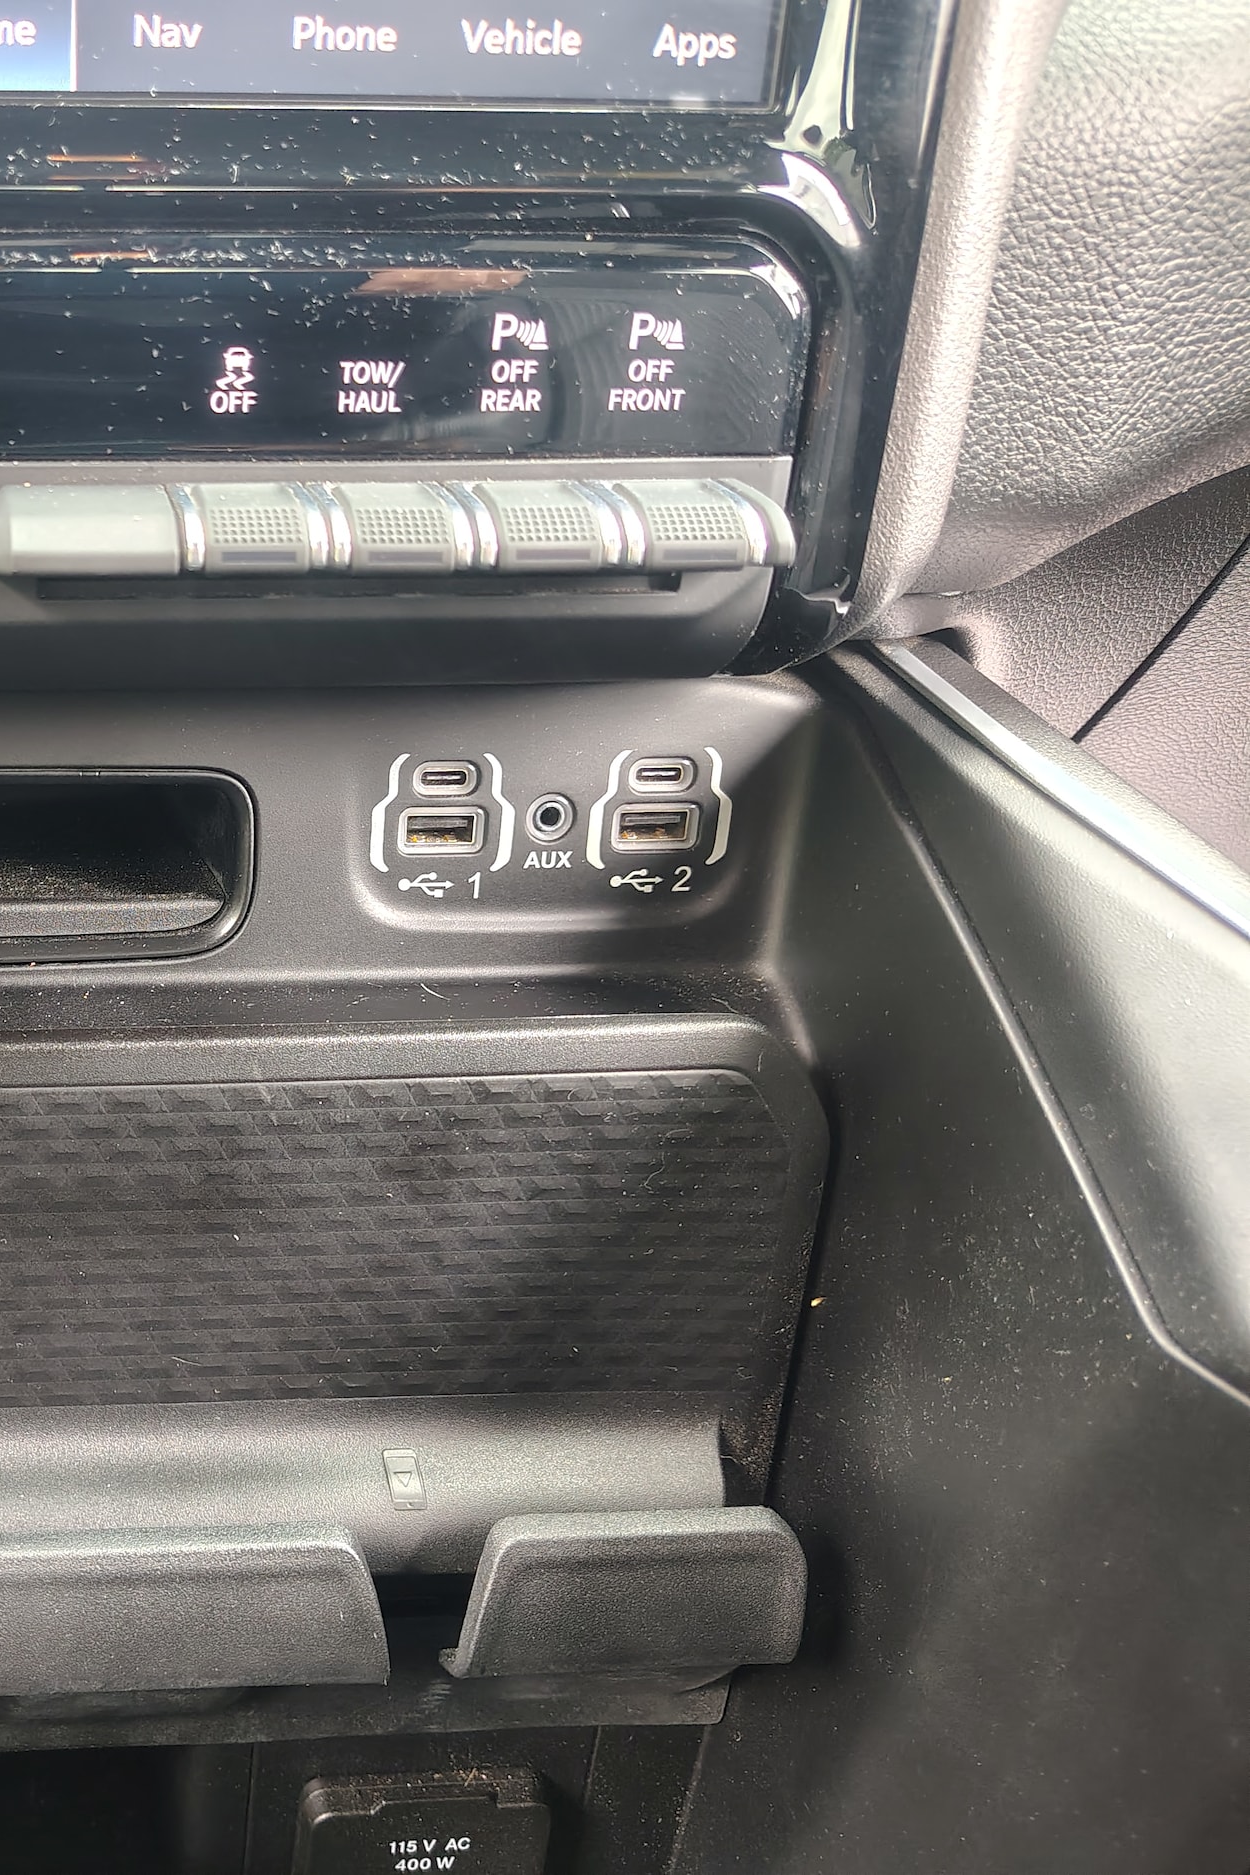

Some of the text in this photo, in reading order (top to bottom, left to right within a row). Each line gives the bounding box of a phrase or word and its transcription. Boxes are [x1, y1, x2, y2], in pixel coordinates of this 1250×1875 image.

[133, 14, 202, 50] Nav
[293, 15, 398, 53] Phone
[461, 18, 582, 56] Vehicle
[653, 23, 737, 66] Apps
[340, 360, 406, 388] TOW/
[492, 358, 539, 384] OFF
[628, 358, 674, 384] OFF
[210, 391, 258, 415] OFF
[338, 391, 402, 414] HAUL
[481, 388, 542, 413] REAR
[608, 388, 686, 412] FRONT
[523, 851, 573, 870] AUX
[467, 872, 482, 899] 1
[670, 866, 692, 892] 2
[389, 1837, 470, 1854] 115 V AC
[395, 1856, 455, 1871] 400 W
